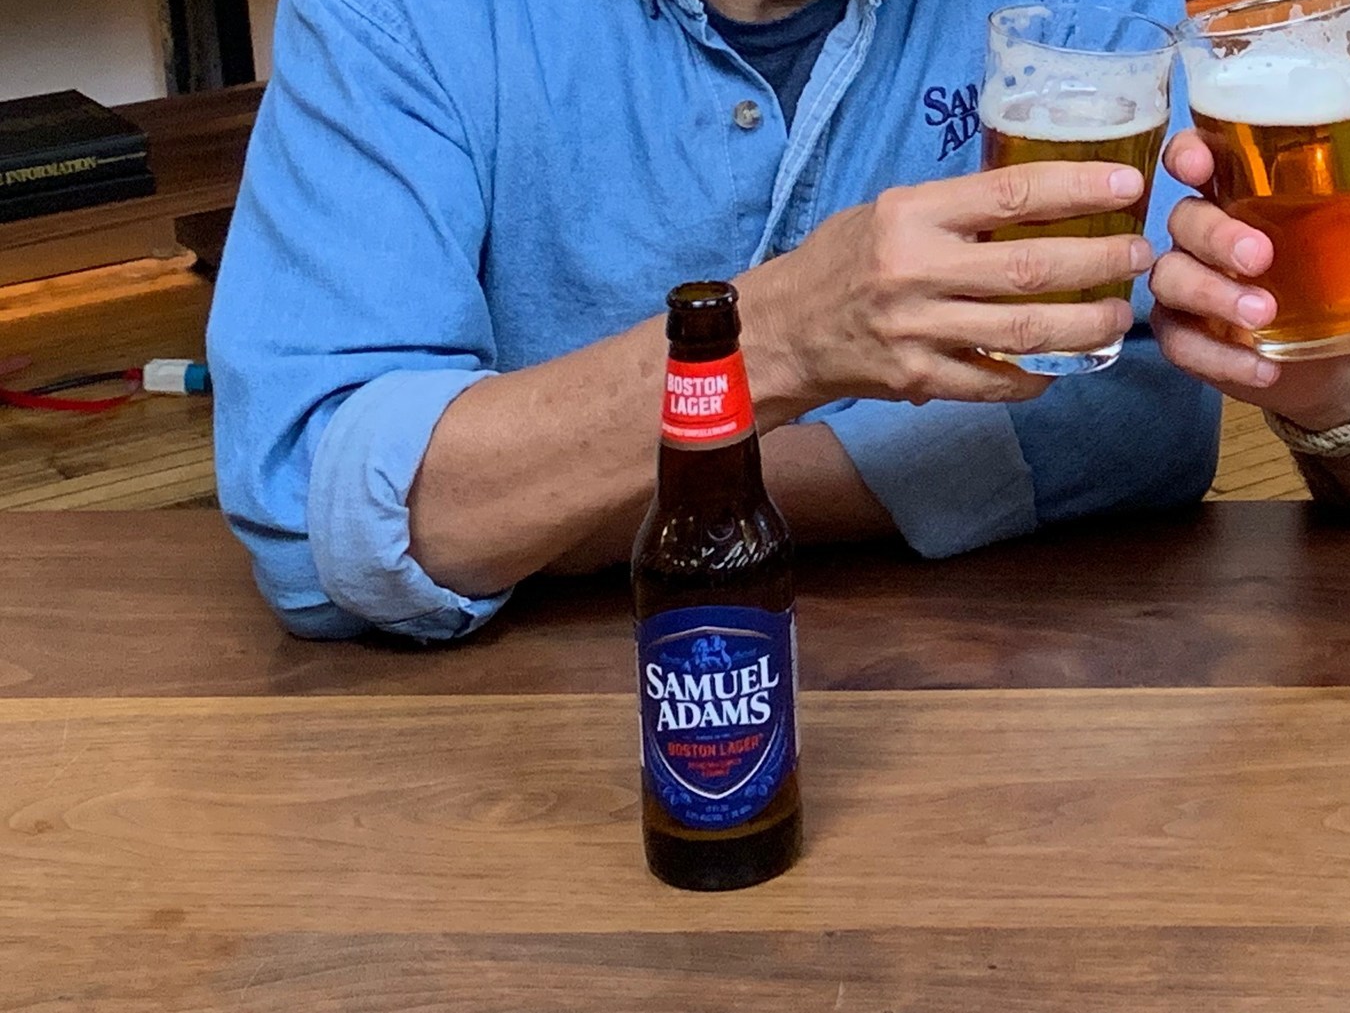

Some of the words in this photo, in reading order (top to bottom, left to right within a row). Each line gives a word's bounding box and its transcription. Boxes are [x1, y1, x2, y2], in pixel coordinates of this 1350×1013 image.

[6, 156, 97, 186] INFORMATION
[667, 372, 729, 396] BOSTON
[670, 395, 725, 416] LAGER
[645, 654, 780, 702] SAMUEL
[656, 690, 772, 732] ADAMS
[667, 741, 717, 758] BOSTON
[719, 733, 761, 756] LAGER
